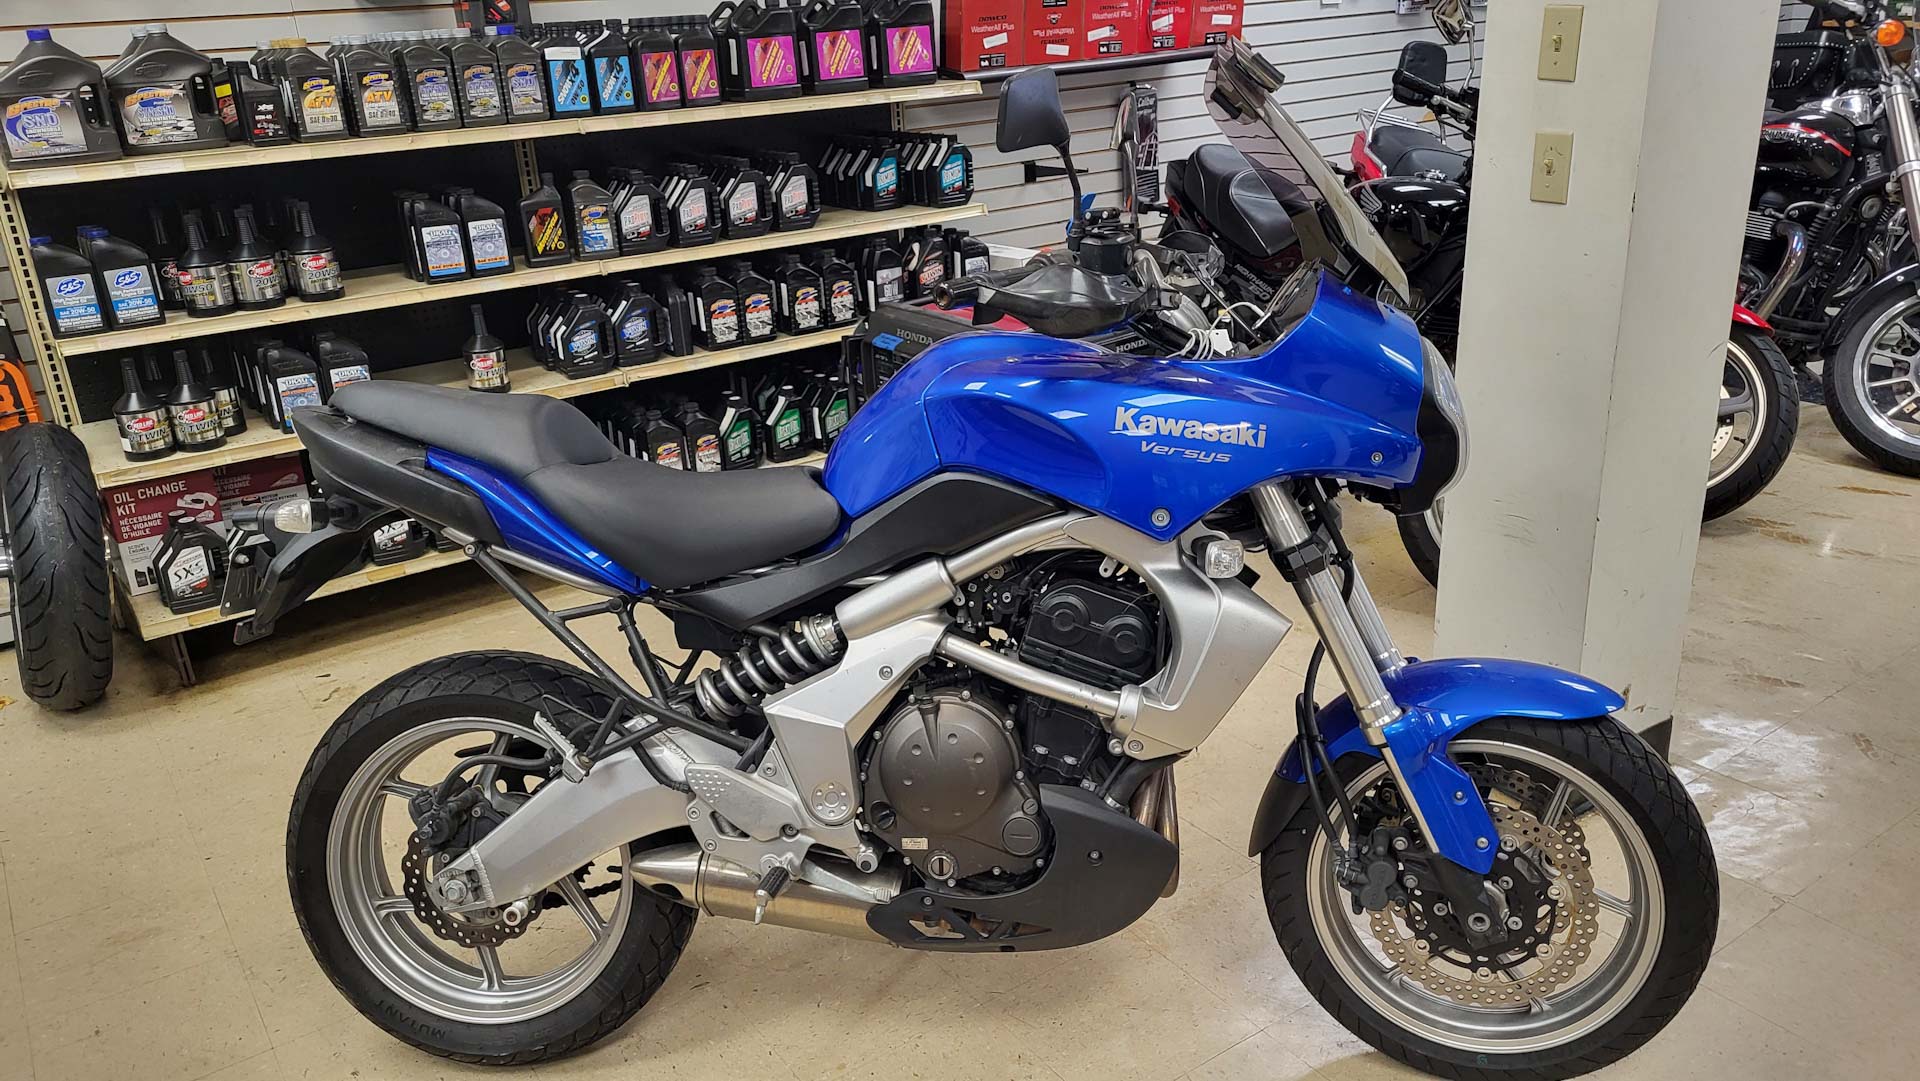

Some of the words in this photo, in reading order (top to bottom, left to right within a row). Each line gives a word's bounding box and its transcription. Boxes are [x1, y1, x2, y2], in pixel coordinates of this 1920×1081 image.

[971, 24, 1001, 33] WeatherAll
[1033, 29, 1046, 37] Plus
[308, 96, 333, 108] ATV
[367, 90, 393, 103] ATV
[22, 112, 58, 128] SNO
[116, 272, 140, 286] S&S
[1234, 264, 1274, 295] NIGHTHAWK
[59, 280, 82, 292] S&S
[1248, 281, 1270, 300] 750
[71, 306, 96, 314] 20W-50
[896, 329, 934, 344] HONDA
[1116, 338, 1148, 353] HOND
[1115, 406, 1267, 448] Kawasaki
[114, 492, 135, 504] OIL
[137, 480, 188, 500] CHANGE
[116, 503, 136, 516] KIT
[120, 512, 163, 526] NÉCESSAIRE
[132, 518, 162, 530] VIDANGE
[123, 528, 151, 540] D'HUILE
